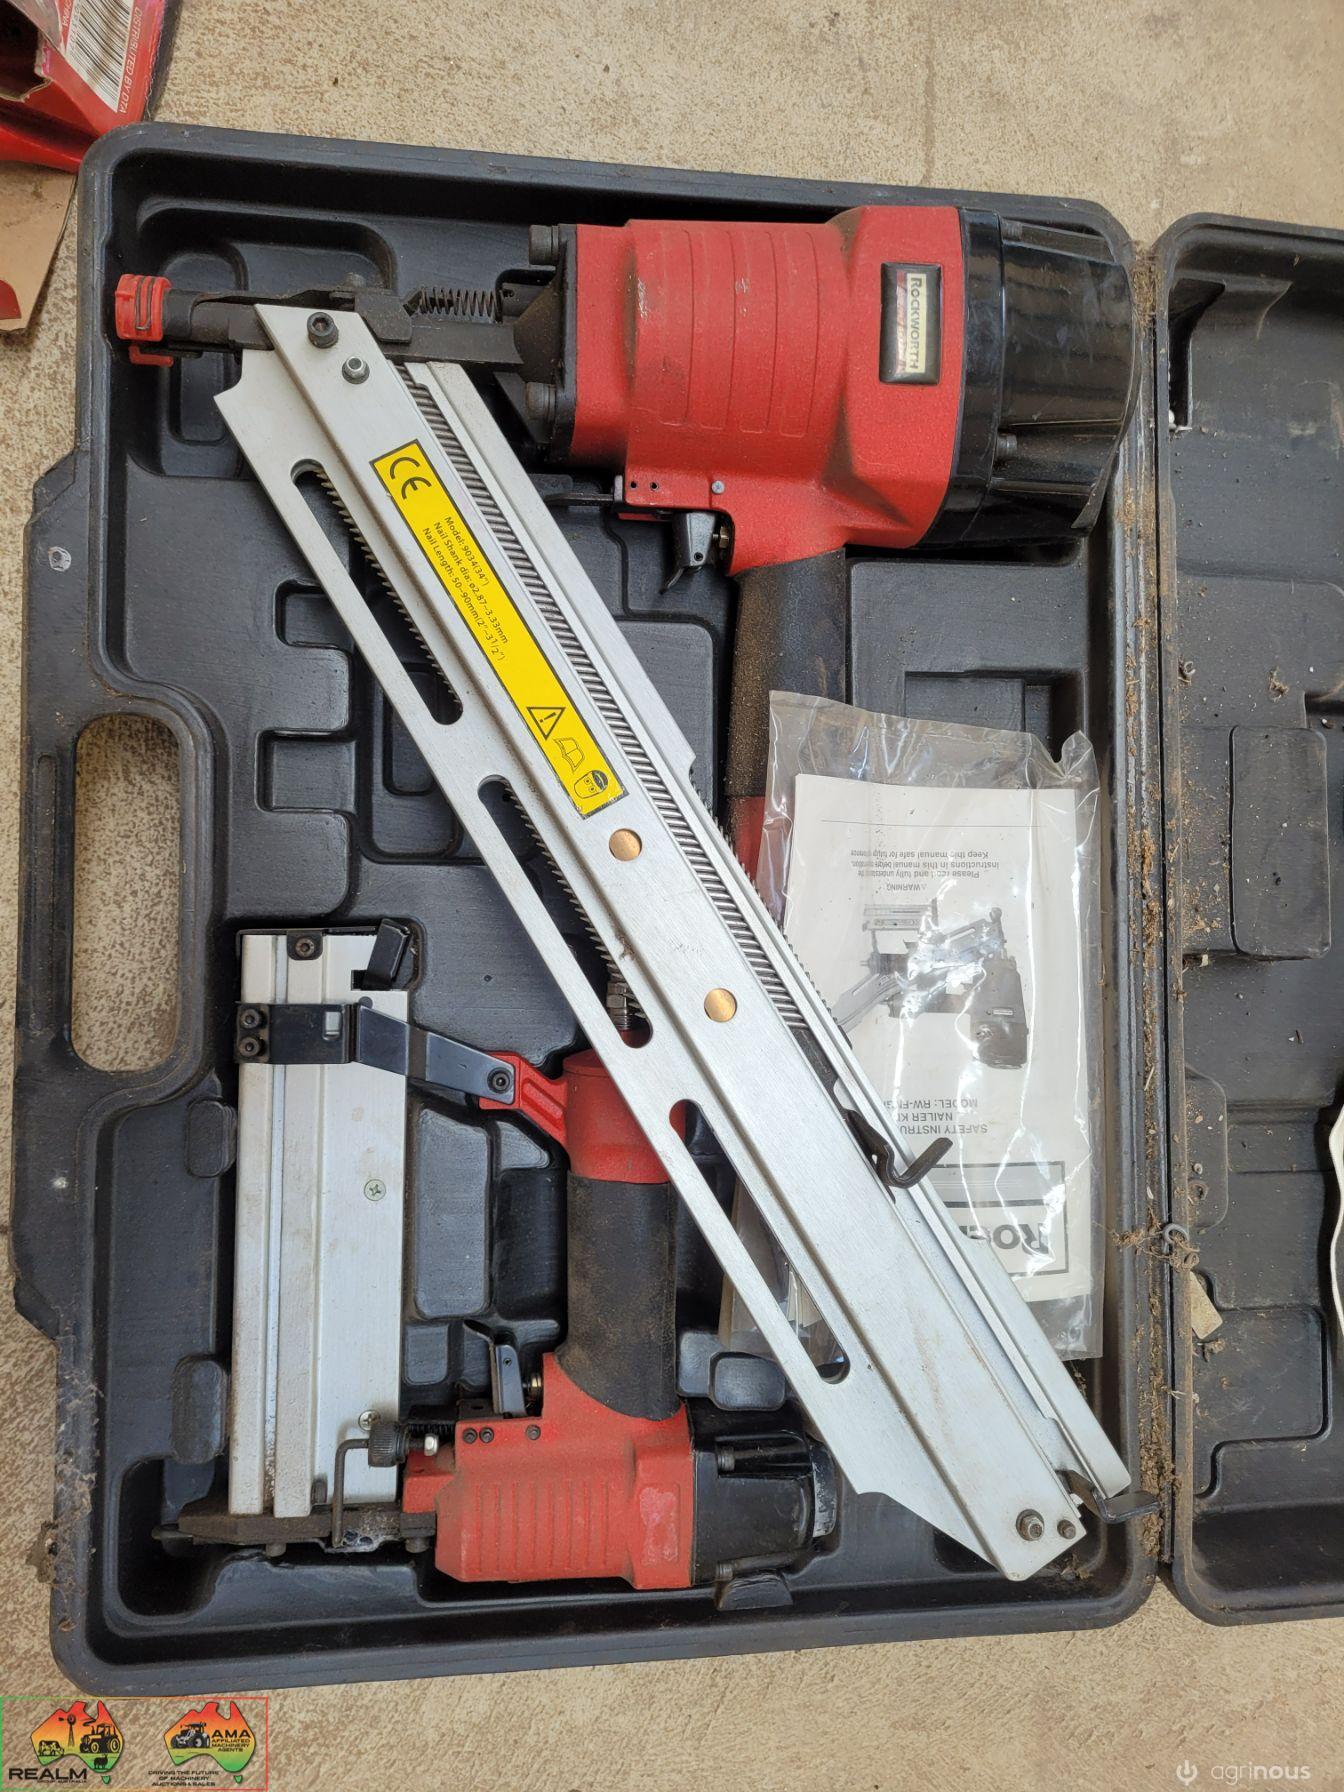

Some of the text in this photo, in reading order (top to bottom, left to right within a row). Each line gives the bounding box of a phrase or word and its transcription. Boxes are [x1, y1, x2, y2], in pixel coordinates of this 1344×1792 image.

[119, 7, 142, 114] DISTRIBUTED BY DTA
[909, 277, 923, 370] ROCKWORTH
[444, 516, 465, 546] Model:
[422, 527, 438, 546] Nail
[433, 544, 455, 578] Length:
[434, 521, 448, 540] Nail
[444, 539, 463, 566] Shank
[460, 566, 472, 583] dia:
[889, 851, 897, 859] for
[899, 851, 915, 859] safe
[917, 851, 948, 859] manual
[968, 850, 988, 859] Keep
[912, 1112, 953, 1121] NAILER
[897, 1124, 987, 1134] SAFETY INSTRU
